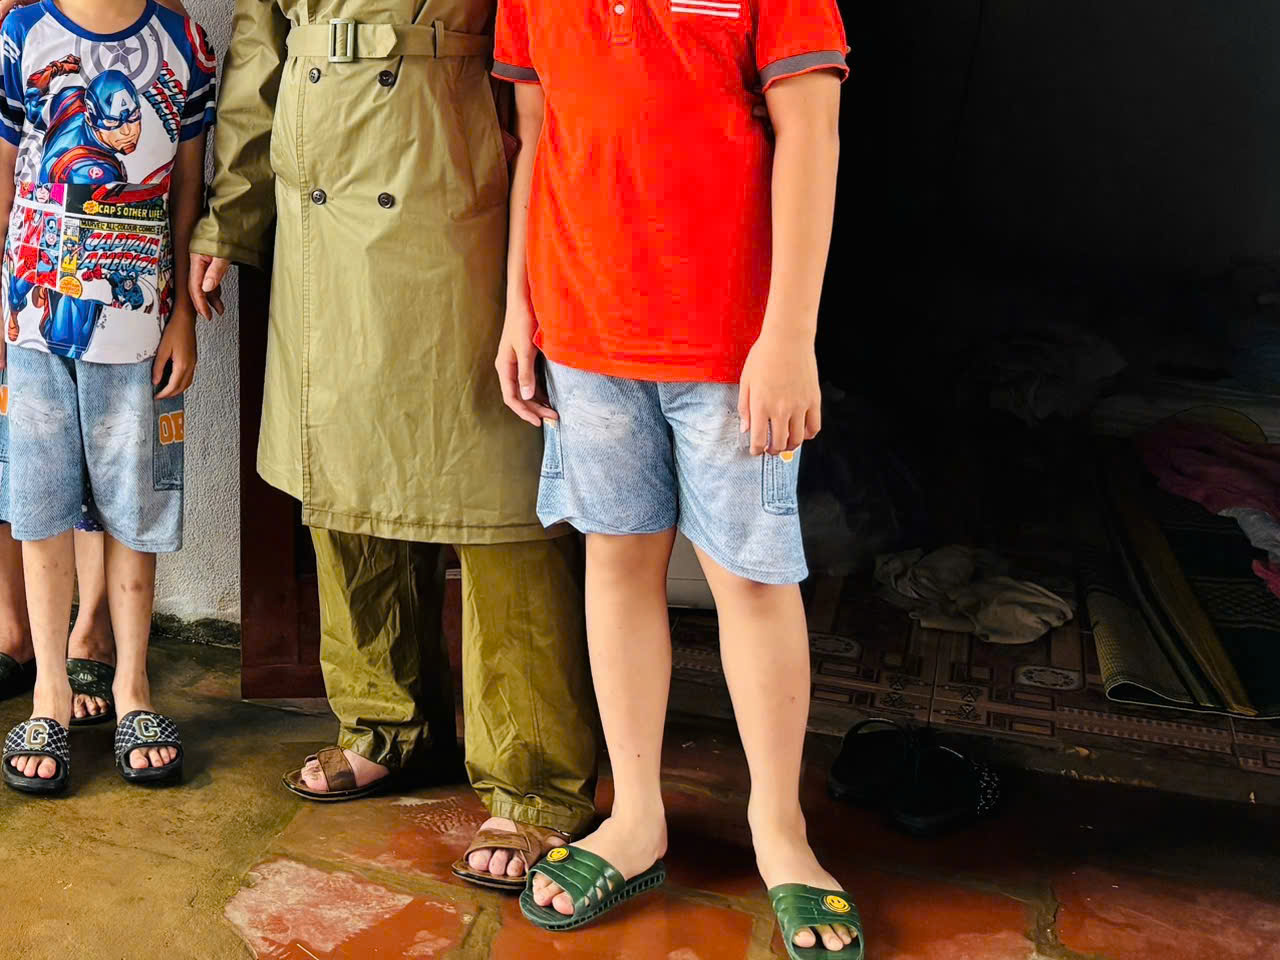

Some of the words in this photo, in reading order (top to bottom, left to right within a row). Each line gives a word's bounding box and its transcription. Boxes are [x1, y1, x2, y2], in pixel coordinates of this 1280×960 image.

[123, 207, 148, 217] OTHER
[83, 232, 160, 256] CAPTAIN
[78, 252, 158, 276] AMERICA
